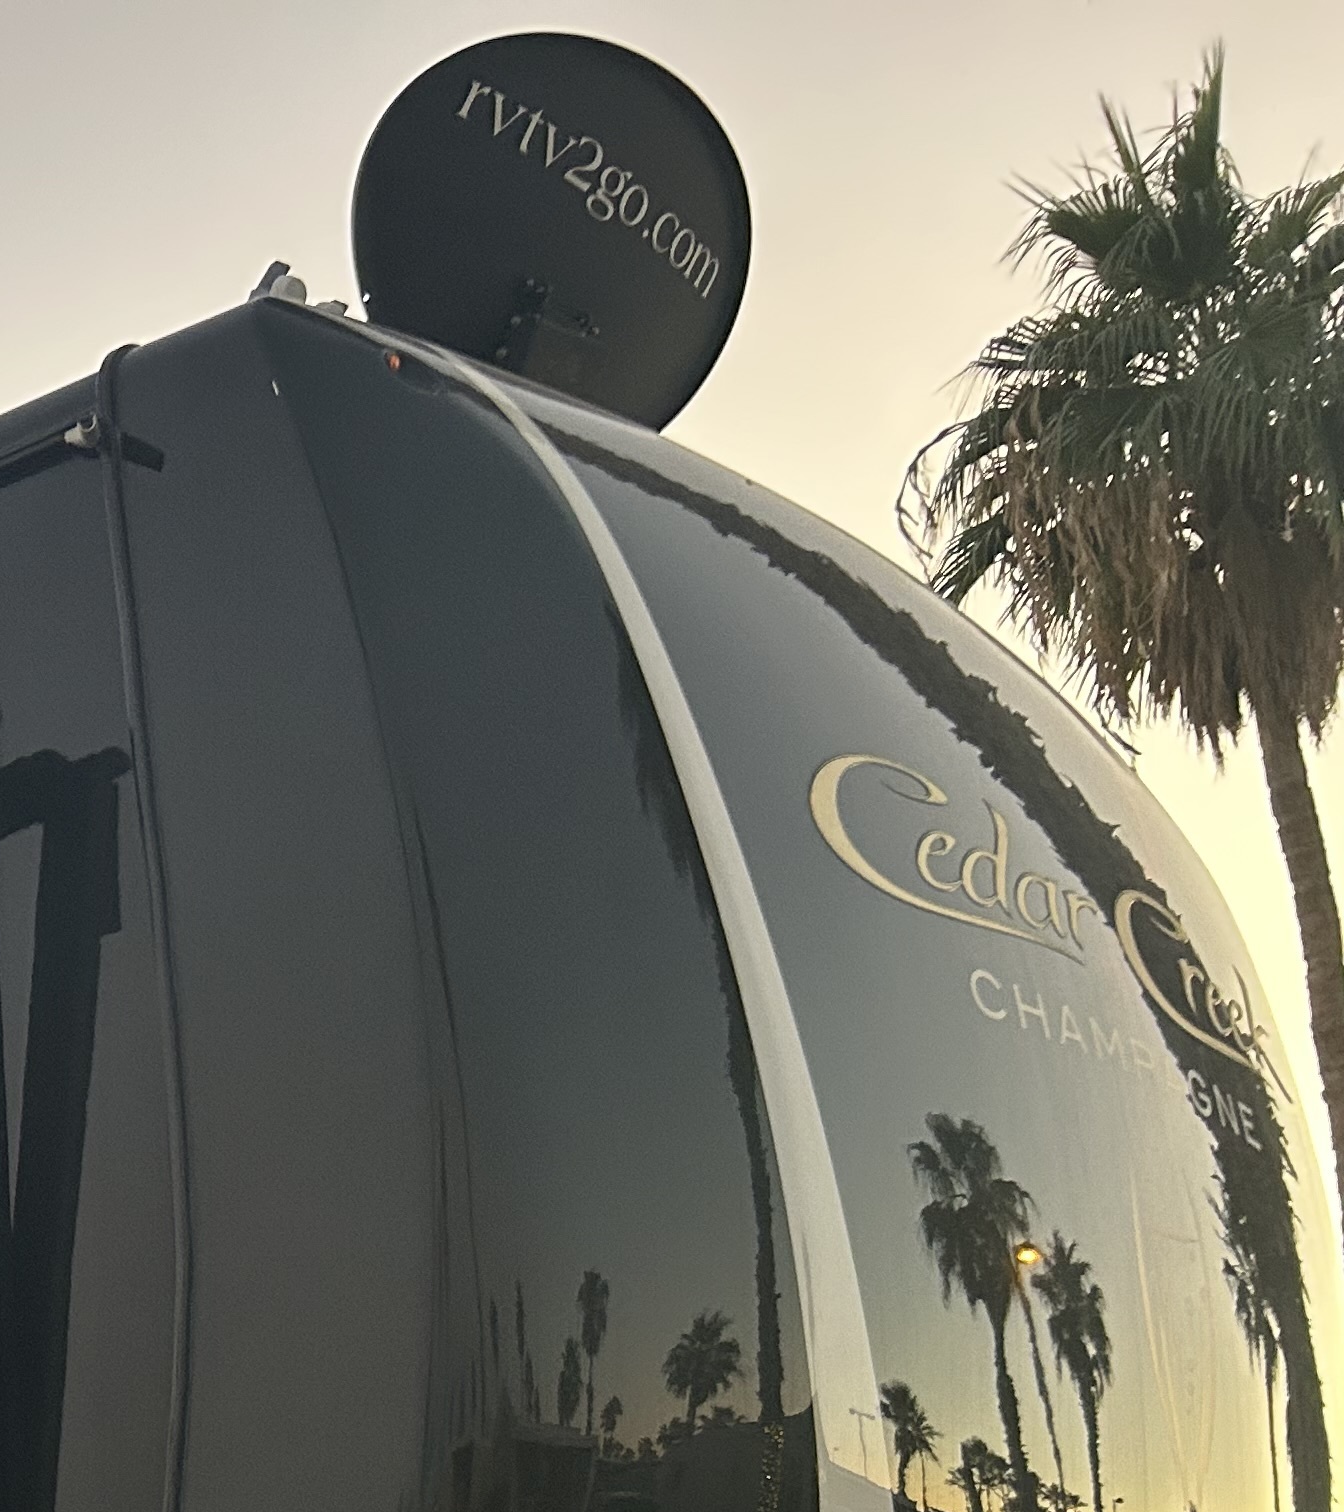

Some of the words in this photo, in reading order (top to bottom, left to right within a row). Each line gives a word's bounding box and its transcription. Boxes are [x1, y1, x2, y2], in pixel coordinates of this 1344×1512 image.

[456, 79, 721, 299] rvtv2go.com
[809, 752, 1099, 967] Cedar
[1113, 889, 1293, 1104] Creek
[968, 968, 1263, 1151] CHAMPGNE
